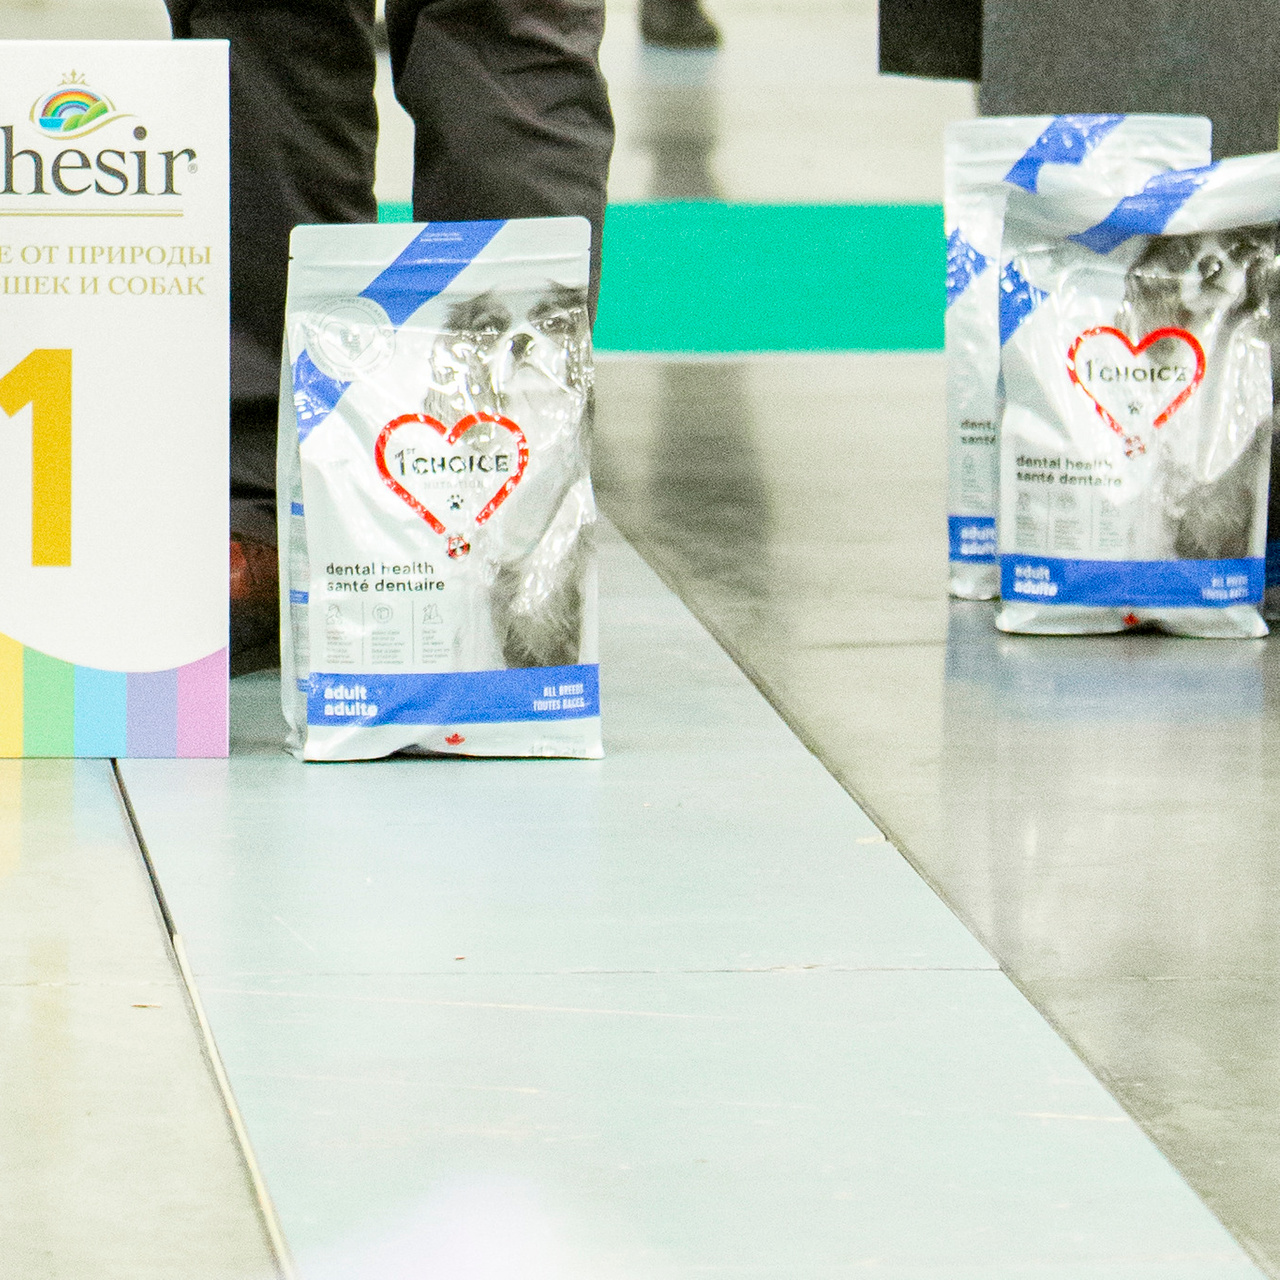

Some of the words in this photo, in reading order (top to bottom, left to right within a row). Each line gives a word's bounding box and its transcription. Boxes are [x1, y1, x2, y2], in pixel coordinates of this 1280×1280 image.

[20, 244, 59, 266] ОТ
[68, 244, 213, 268] ПРИРОДЫ
[80, 275, 99, 295] И
[108, 275, 206, 296] СОБАК
[412, 454, 509, 474] CHOICE
[1015, 455, 1061, 470] dental
[423, 480, 485, 491] NUTRTION
[326, 561, 376, 576] dental
[381, 561, 435, 575] health
[327, 579, 370, 593] santé
[375, 577, 446, 593] dentaire
[324, 685, 367, 700] adult
[324, 702, 378, 717] adulte
